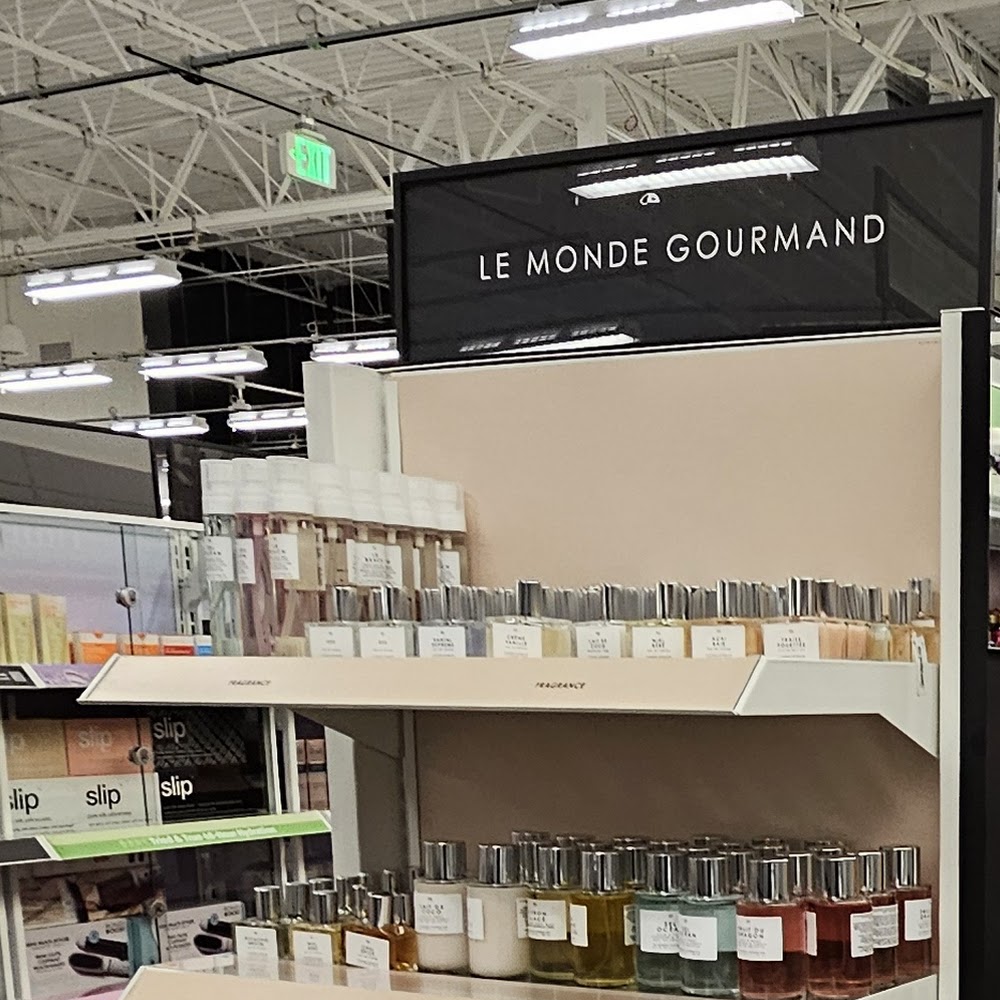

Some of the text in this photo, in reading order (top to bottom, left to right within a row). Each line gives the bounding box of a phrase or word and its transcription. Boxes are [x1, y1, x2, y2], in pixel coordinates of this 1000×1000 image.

[295, 134, 332, 185] EXIT
[479, 213, 885, 281] LE MONDE GOURMAND
[535, 681, 586, 689] FRAGRANCE
[153, 717, 186, 744] slip
[86, 784, 121, 809] slip
[161, 775, 193, 800] slip
